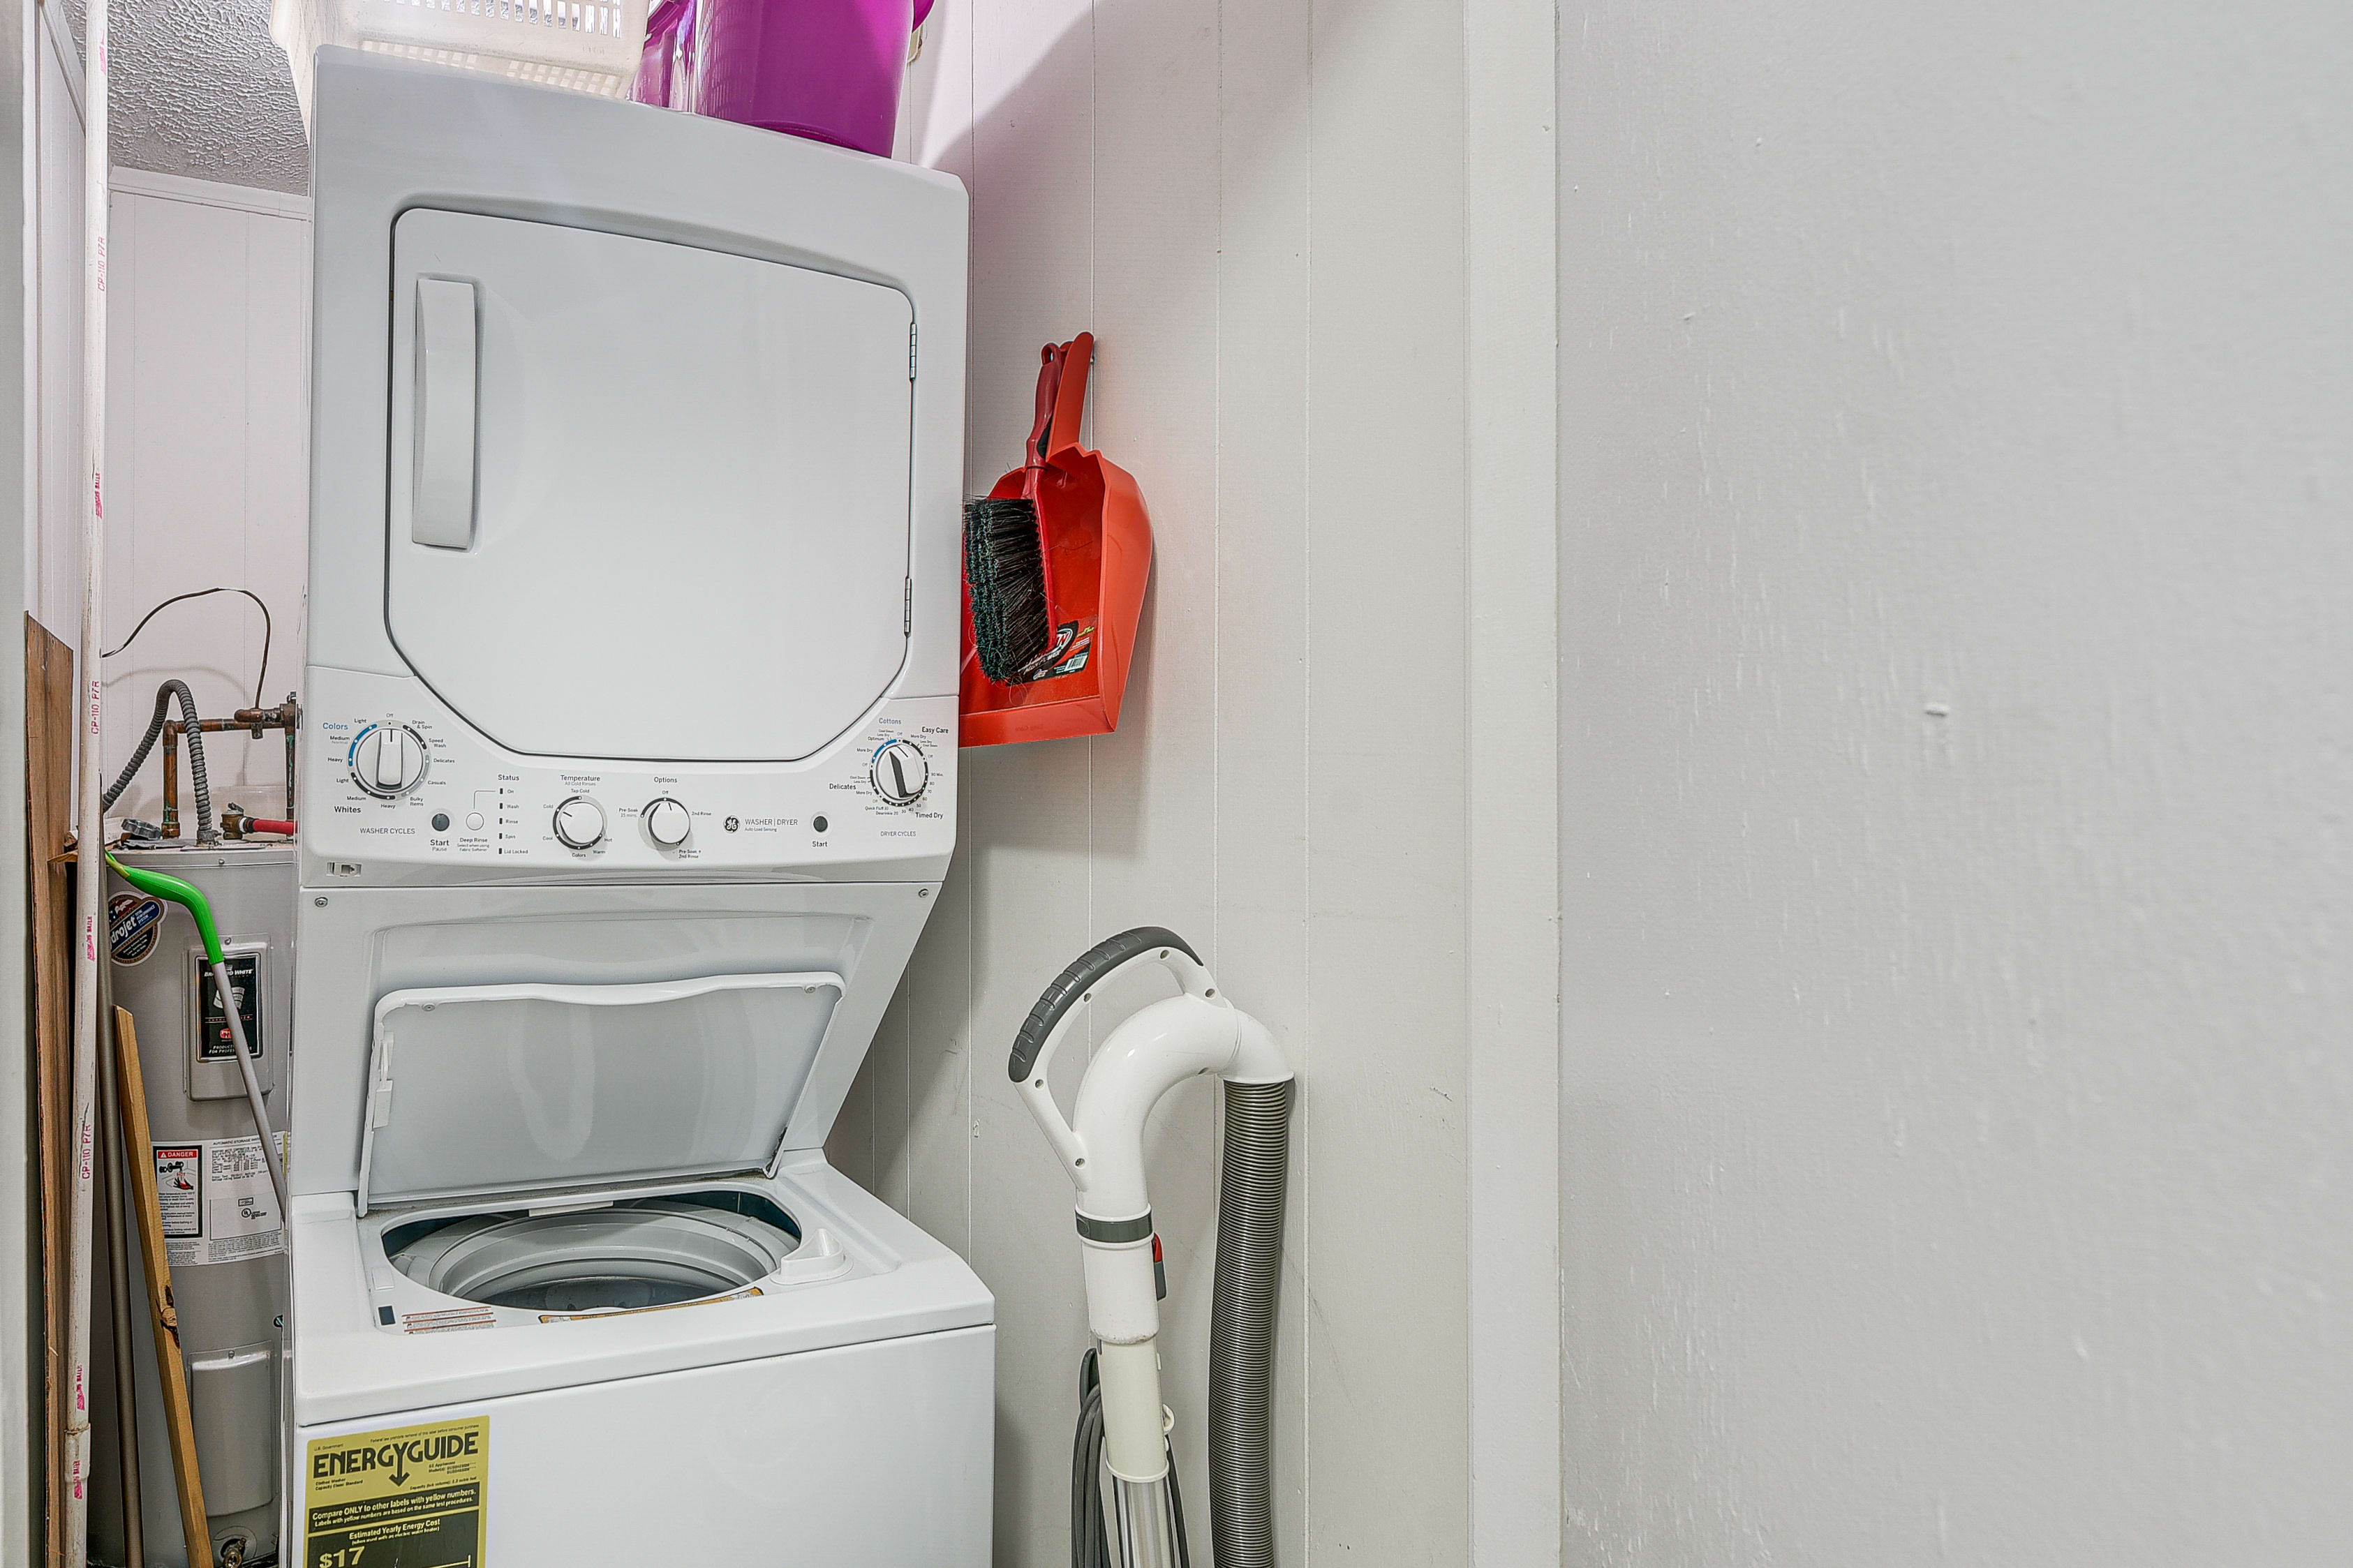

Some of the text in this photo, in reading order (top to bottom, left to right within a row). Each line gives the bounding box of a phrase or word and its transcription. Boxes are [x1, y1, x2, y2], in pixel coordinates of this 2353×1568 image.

[82, 1149, 90, 1179] CP-110
[313, 1431, 479, 1479] ENERGYGUIDE
[313, 1510, 343, 1520] Compare
[344, 1506, 362, 1515] ONLY
[372, 1502, 389, 1511] other
[391, 1498, 409, 1507] labels
[426, 1493, 446, 1503] yellow
[447, 1489, 476, 1499] numbers.
[446, 1497, 473, 1507] procedures.
[349, 1528, 381, 1540] Estimated
[382, 1525, 401, 1535] Yearly
[402, 1521, 425, 1531] Energy
[319, 1546, 365, 1568] $17
